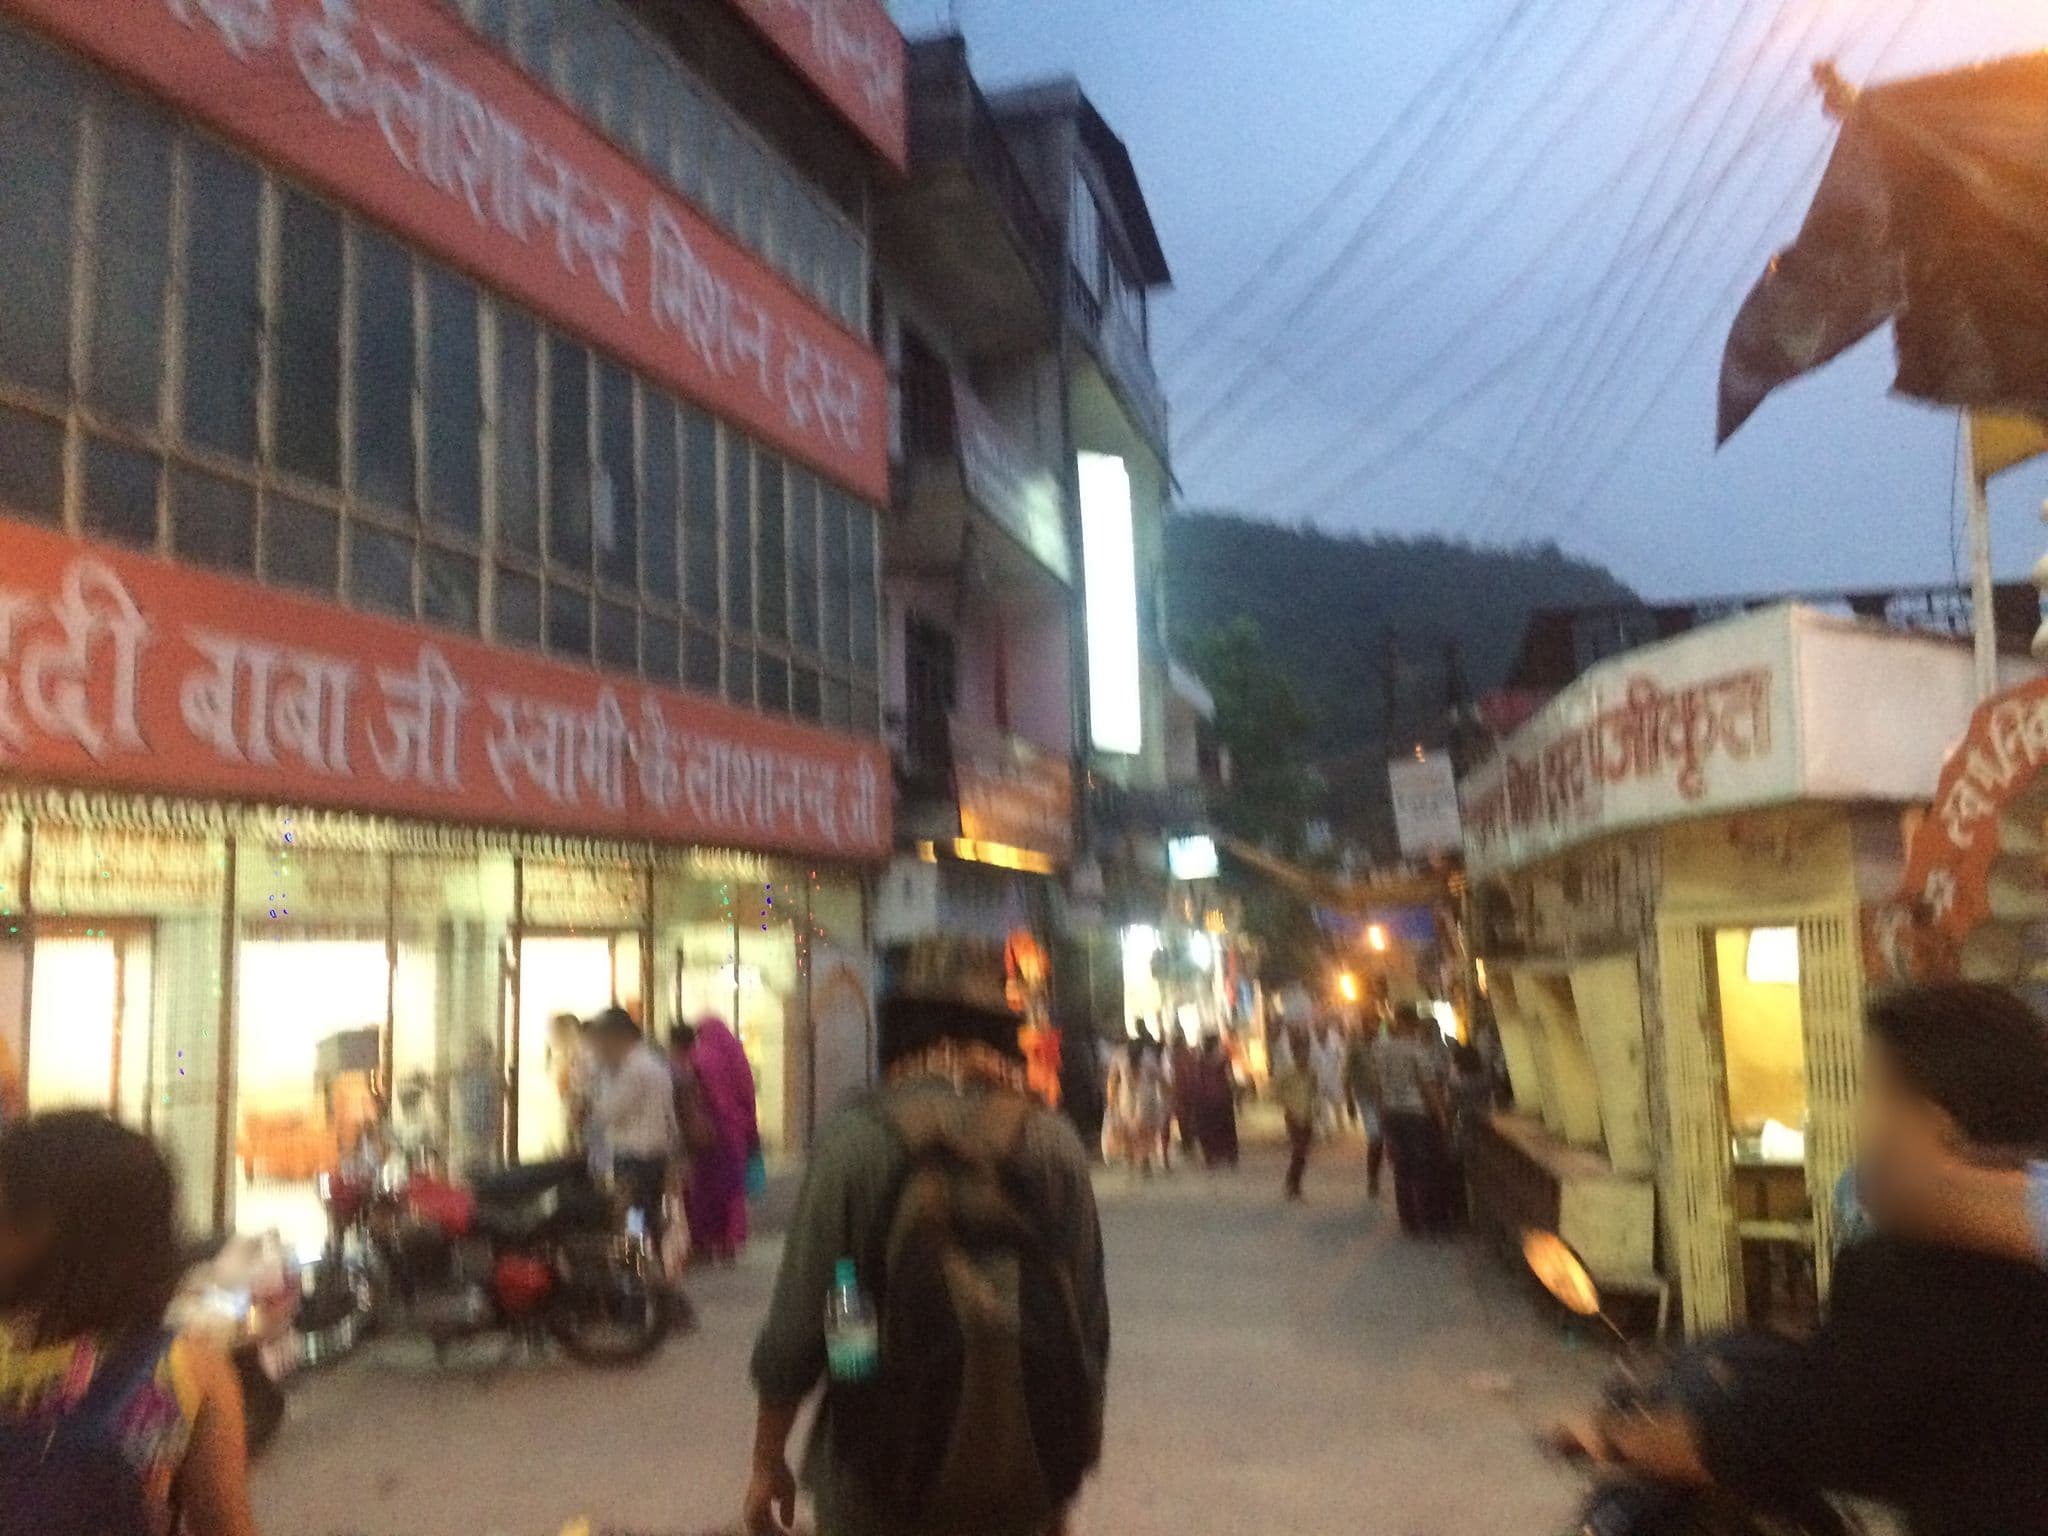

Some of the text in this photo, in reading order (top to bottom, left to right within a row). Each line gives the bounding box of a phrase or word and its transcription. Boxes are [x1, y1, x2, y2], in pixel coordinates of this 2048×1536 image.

[180, 624, 360, 777] बाबा
[364, 640, 470, 797] जी
[485, 686, 629, 814] स्वामी
